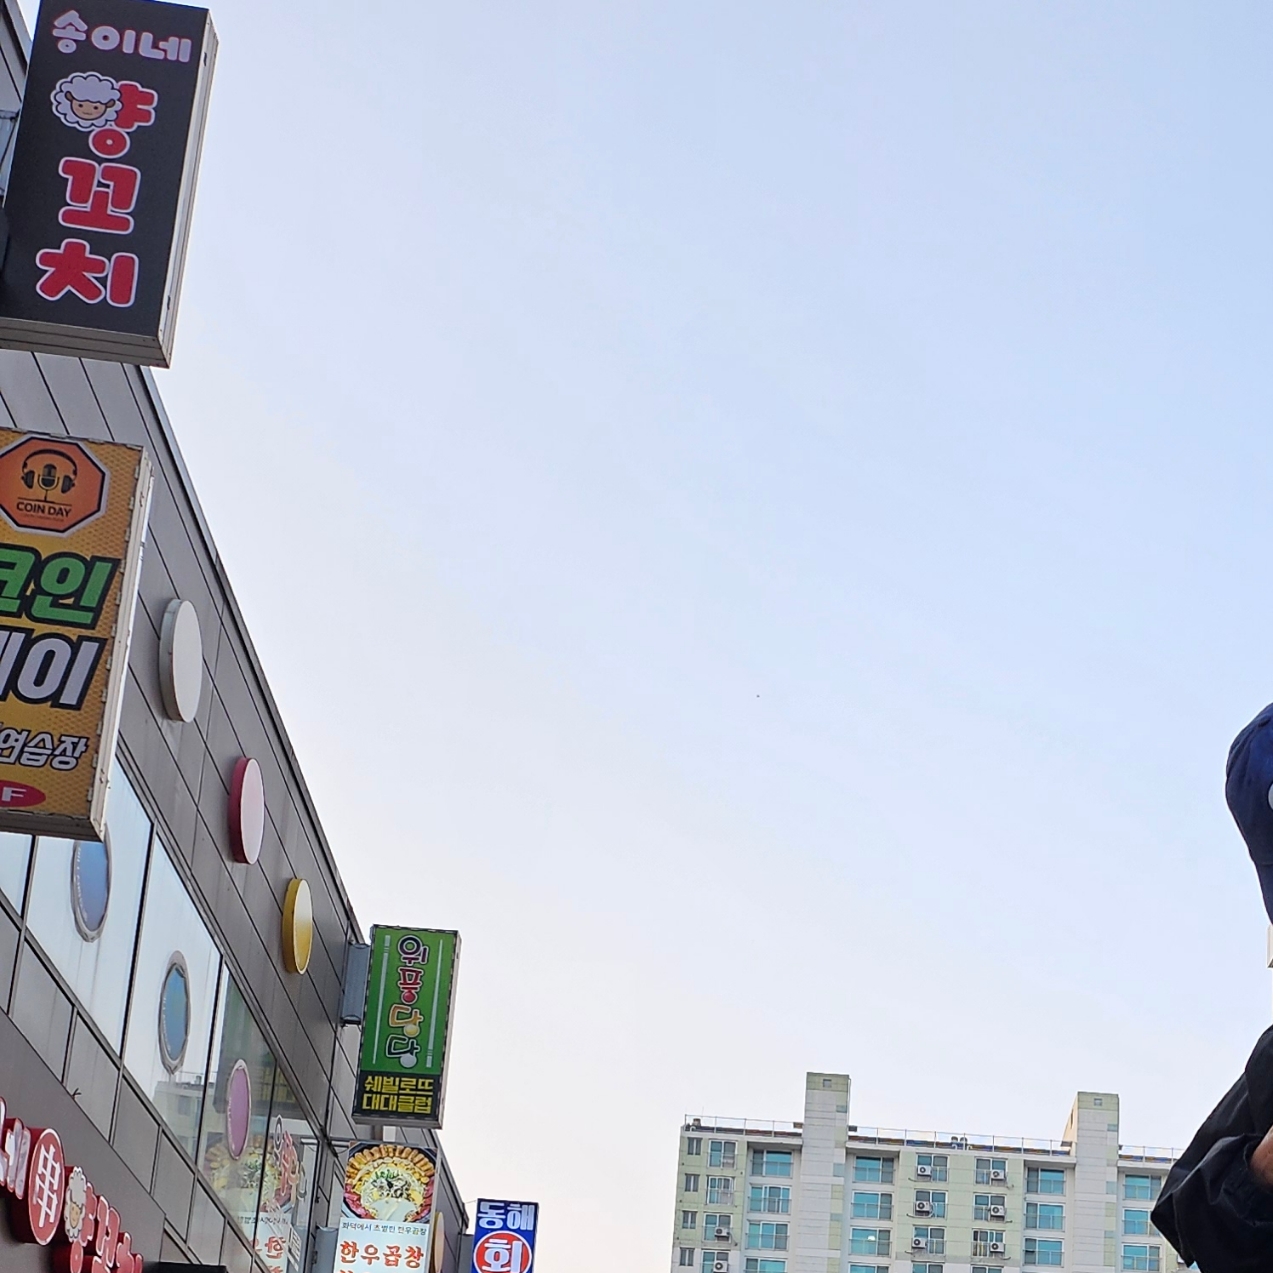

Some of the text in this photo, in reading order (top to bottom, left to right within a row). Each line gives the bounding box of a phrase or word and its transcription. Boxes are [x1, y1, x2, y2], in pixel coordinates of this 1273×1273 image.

[52, 9, 192, 64] 송이네
[36, 72, 158, 308] 양꼬치
[16, 502, 46, 515] COIN
[48, 504, 72, 519] DAY
[386, 934, 429, 1068] 위풍당당
[362, 1093, 433, 1114] 대대클럽
[477, 1202, 534, 1231] 동해
[340, 1240, 424, 1269] 한우곱창
